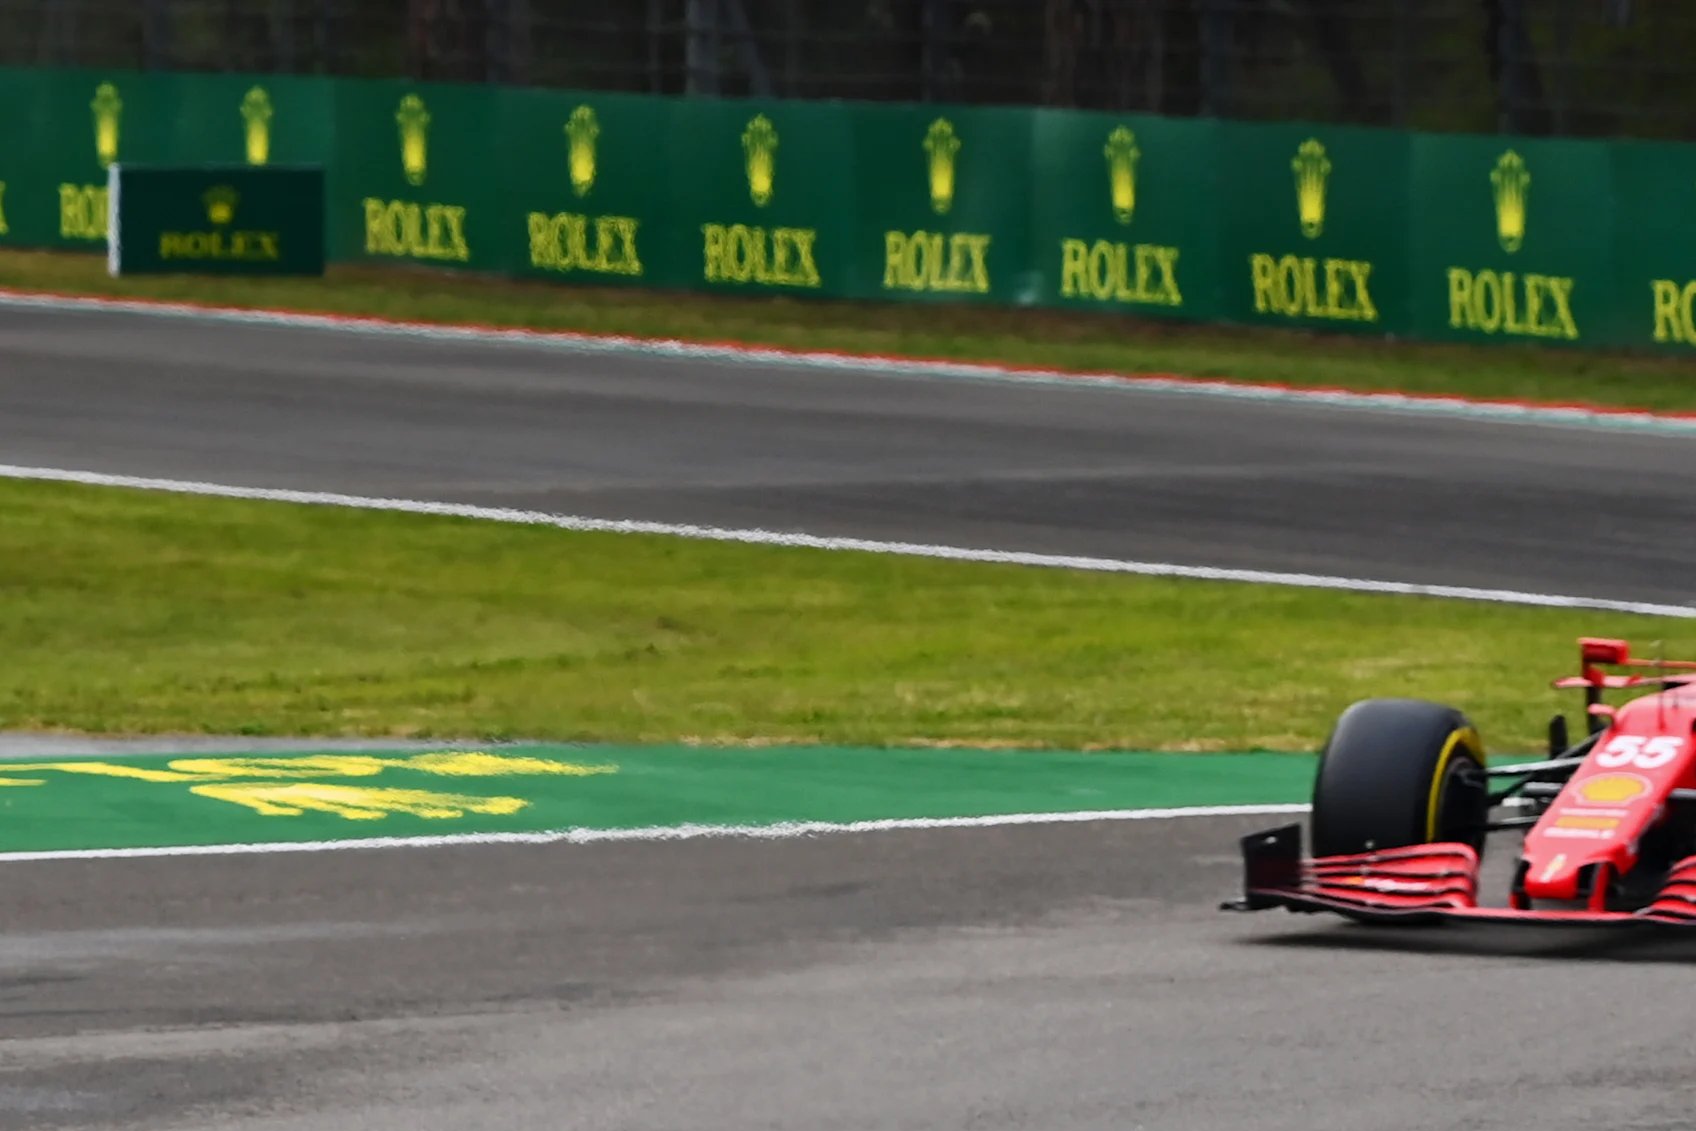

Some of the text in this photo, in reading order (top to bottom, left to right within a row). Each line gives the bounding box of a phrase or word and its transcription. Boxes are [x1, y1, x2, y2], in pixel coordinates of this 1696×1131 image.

[366, 200, 467, 259] ROLEX
[529, 213, 640, 273] ROLEX
[705, 224, 819, 285] ROLEX
[885, 231, 988, 291] ROLEX
[1062, 241, 1181, 304] ROLEX
[1252, 255, 1375, 320] ROLEX
[1449, 268, 1576, 337] ROLEX
[1595, 735, 1685, 769] 55
